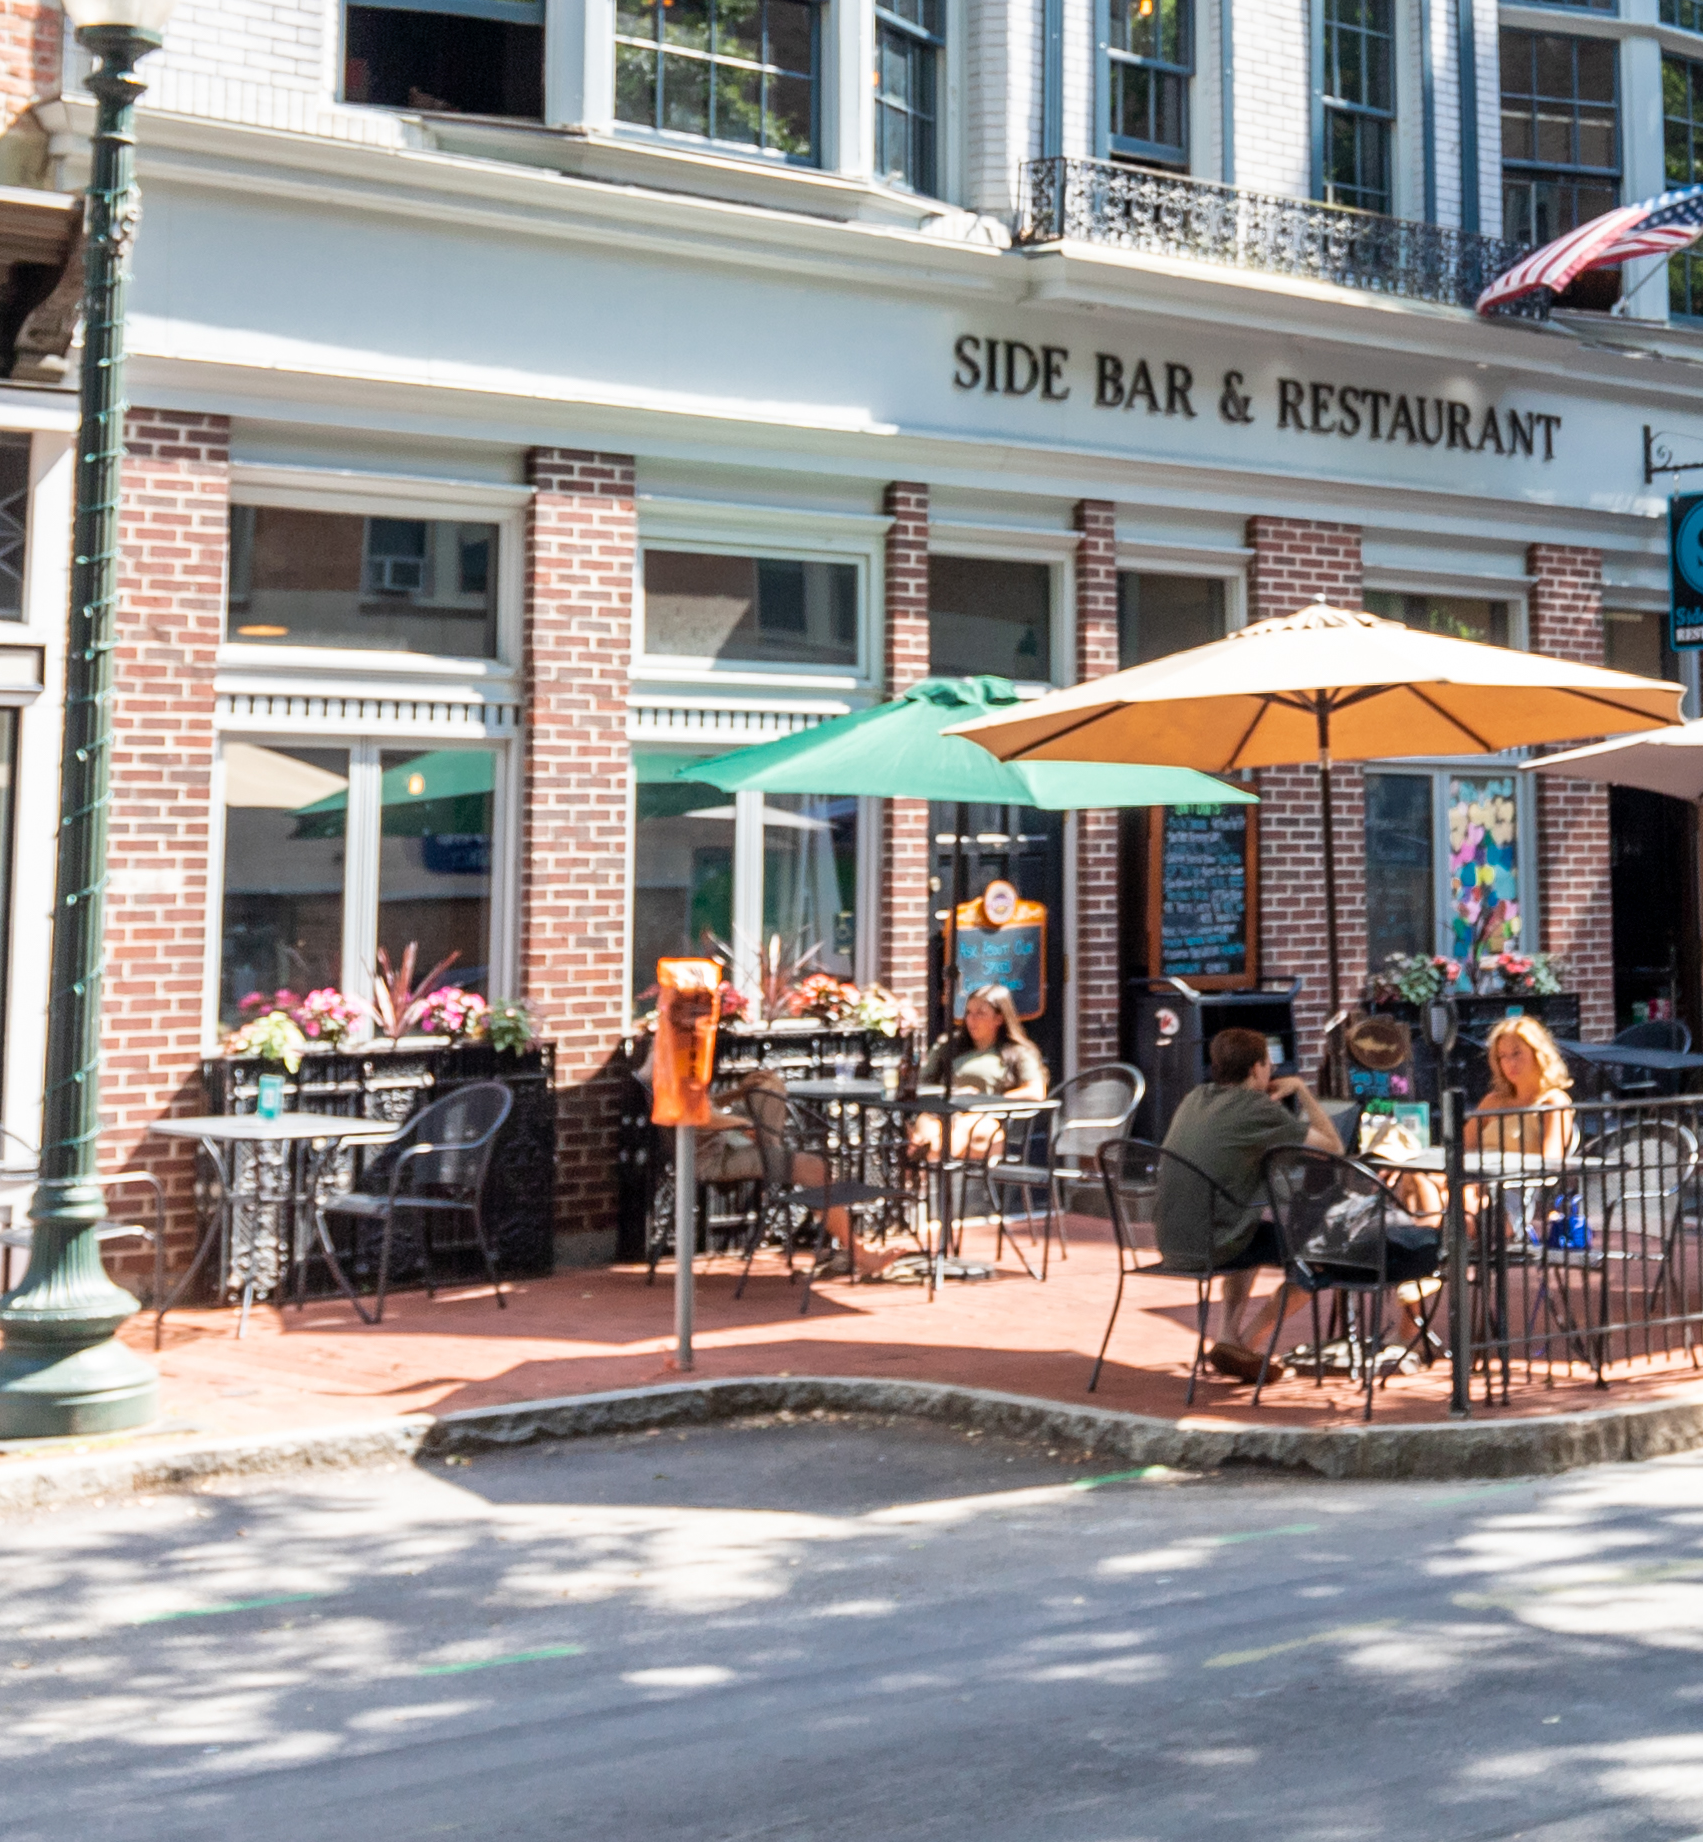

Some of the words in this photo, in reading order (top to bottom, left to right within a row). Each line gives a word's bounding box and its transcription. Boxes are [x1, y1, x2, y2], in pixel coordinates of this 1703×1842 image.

[954, 334, 1070, 401] SIDE
[1095, 351, 1197, 418] BAR
[1219, 369, 1254, 425] &
[1277, 377, 1562, 462] RESTAURANT
